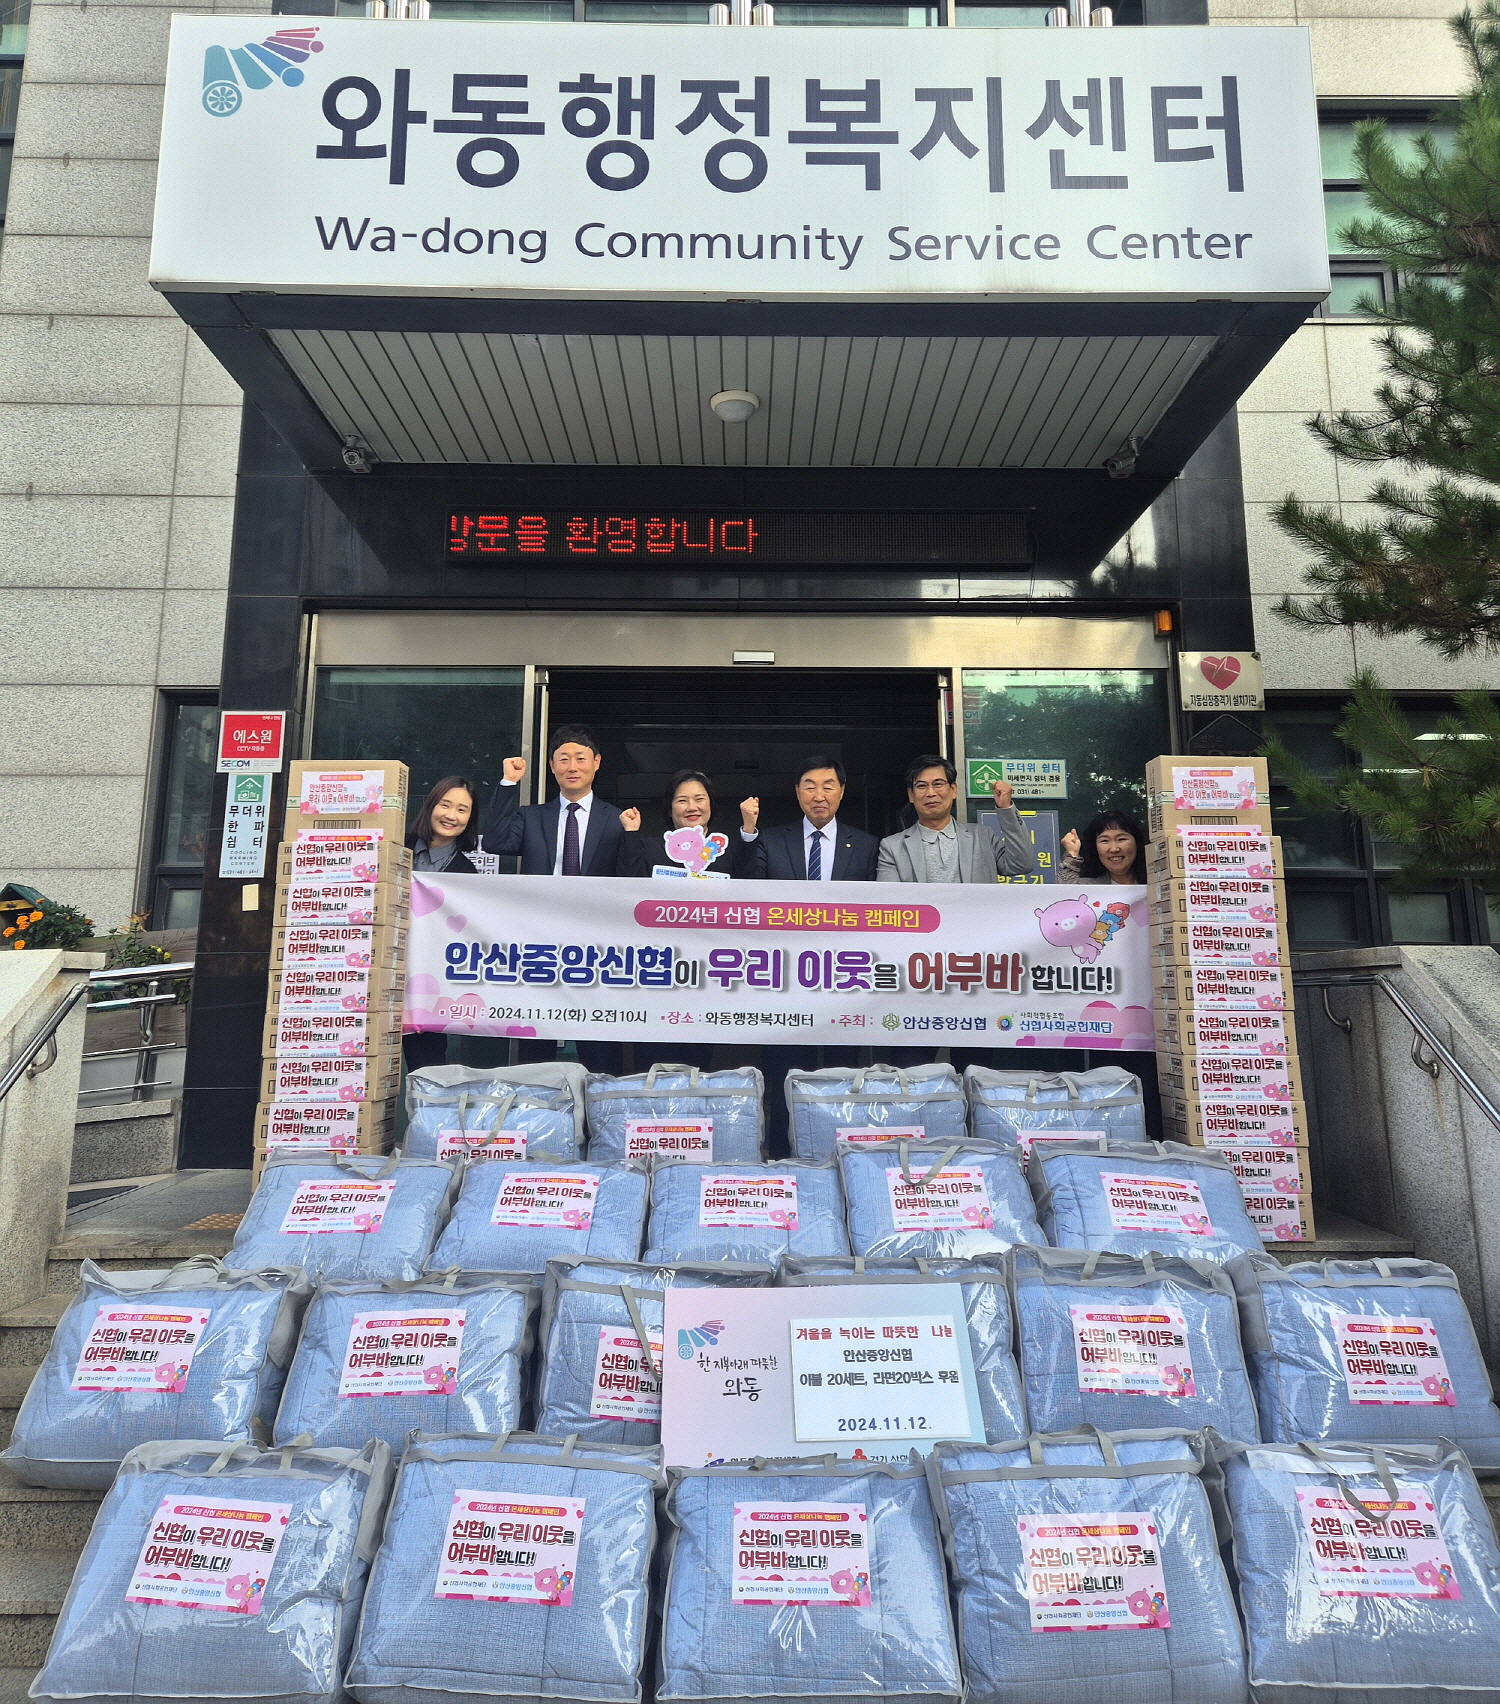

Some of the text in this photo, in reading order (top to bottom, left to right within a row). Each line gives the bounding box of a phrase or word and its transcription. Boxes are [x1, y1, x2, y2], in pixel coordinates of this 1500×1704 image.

[316, 69, 1244, 193] 와동행정복지센터
[315, 216, 1253, 270] Wa-dong Community Service Center
[566, 517, 758, 553] 환영합니다
[1190, 695, 1257, 706] 자동심장충격기 설치기관
[233, 730, 272, 743] 에스원
[1006, 763, 1060, 773] 무더위 쉼터
[229, 805, 265, 817] 무더위
[296, 842, 374, 854] 신협이 우리 이웃을
[1188, 840, 1267, 852] 신협이 우리 이웃을
[296, 857, 351, 867] 어부바합니다!
[1188, 854, 1245, 864] 어부바합니다!
[655, 906, 919, 927] 2024년 신협 온세상나눔 캠페인
[445, 942, 1114, 993] 안산중앙신협이 우리 이웃을 어부바 합니다!
[286, 971, 364, 983] 신협이 우리 이웃을
[285, 985, 340, 996] 어부바합니다!
[450, 1007, 476, 1019] 일시
[488, 1007, 586, 1022] 2024.11.12(화)
[667, 1012, 813, 1027] 장소 와동행정복지센터
[1020, 1012, 1064, 1020] 사회적협동조합
[839, 1014, 986, 1031] 주최 안산중앙신협
[1020, 1020, 1113, 1033] 신협사회공헌재단
[1201, 1059, 1283, 1071] 신협이 우리 이웃을
[1202, 1073, 1261, 1084] 어부바합니다!
[274, 1109, 354, 1120] 신협이 우리 이웃을
[272, 1123, 330, 1134] 어부바합니다!
[629, 1138, 708, 1149] 신협이 우리 이웃을
[738, 1188, 760, 1196] 우리
[926, 1184, 948, 1194] 우리
[329, 1194, 352, 1202] 우리
[92, 1328, 195, 1344] 신협이 우리 이웃을
[796, 1328, 832, 1340] 겨울을
[840, 1327, 875, 1339] 녹이는
[883, 1326, 918, 1339] 따뜻한
[1079, 1328, 1184, 1346] 신협이 우리 이웃을
[353, 1333, 457, 1350] 신협이 우리 이웃을
[1343, 1340, 1439, 1356] 신협이 우리 이웃을
[85, 1347, 158, 1362] 어부바합니다!
[349, 1352, 424, 1368] 어부바합니다!
[602, 1353, 637, 1370] 신협이
[697, 1352, 710, 1372] 한
[843, 1348, 913, 1362] 안산중앙신협
[1081, 1347, 1156, 1363] 어부바합니다!
[1347, 1359, 1416, 1374] 어부바합니다!
[599, 1373, 662, 1392] 어부바합니
[800, 1371, 959, 1386] 이불 20세트, 라면20박스 후원
[722, 1377, 762, 1401] 와동
[838, 1416, 931, 1431] 2024.11.12.
[453, 1520, 574, 1544] 신협이 우리 이웃을
[1310, 1517, 1436, 1538] 신협이 우리 이웃을
[153, 1522, 274, 1552] 신협이 우리 이웃을
[739, 1529, 862, 1546] 신협이 우리 이웃을
[448, 1543, 535, 1565] 어부바합니다!
[1029, 1545, 1156, 1567] 신협이 우리 이웃을
[1315, 1540, 1406, 1560] 어부바합니다!
[145, 1546, 231, 1571] 어부바합니다!
[739, 1551, 826, 1568] 어부바합니다!
[1032, 1572, 1122, 1593] 어부바합니다!
